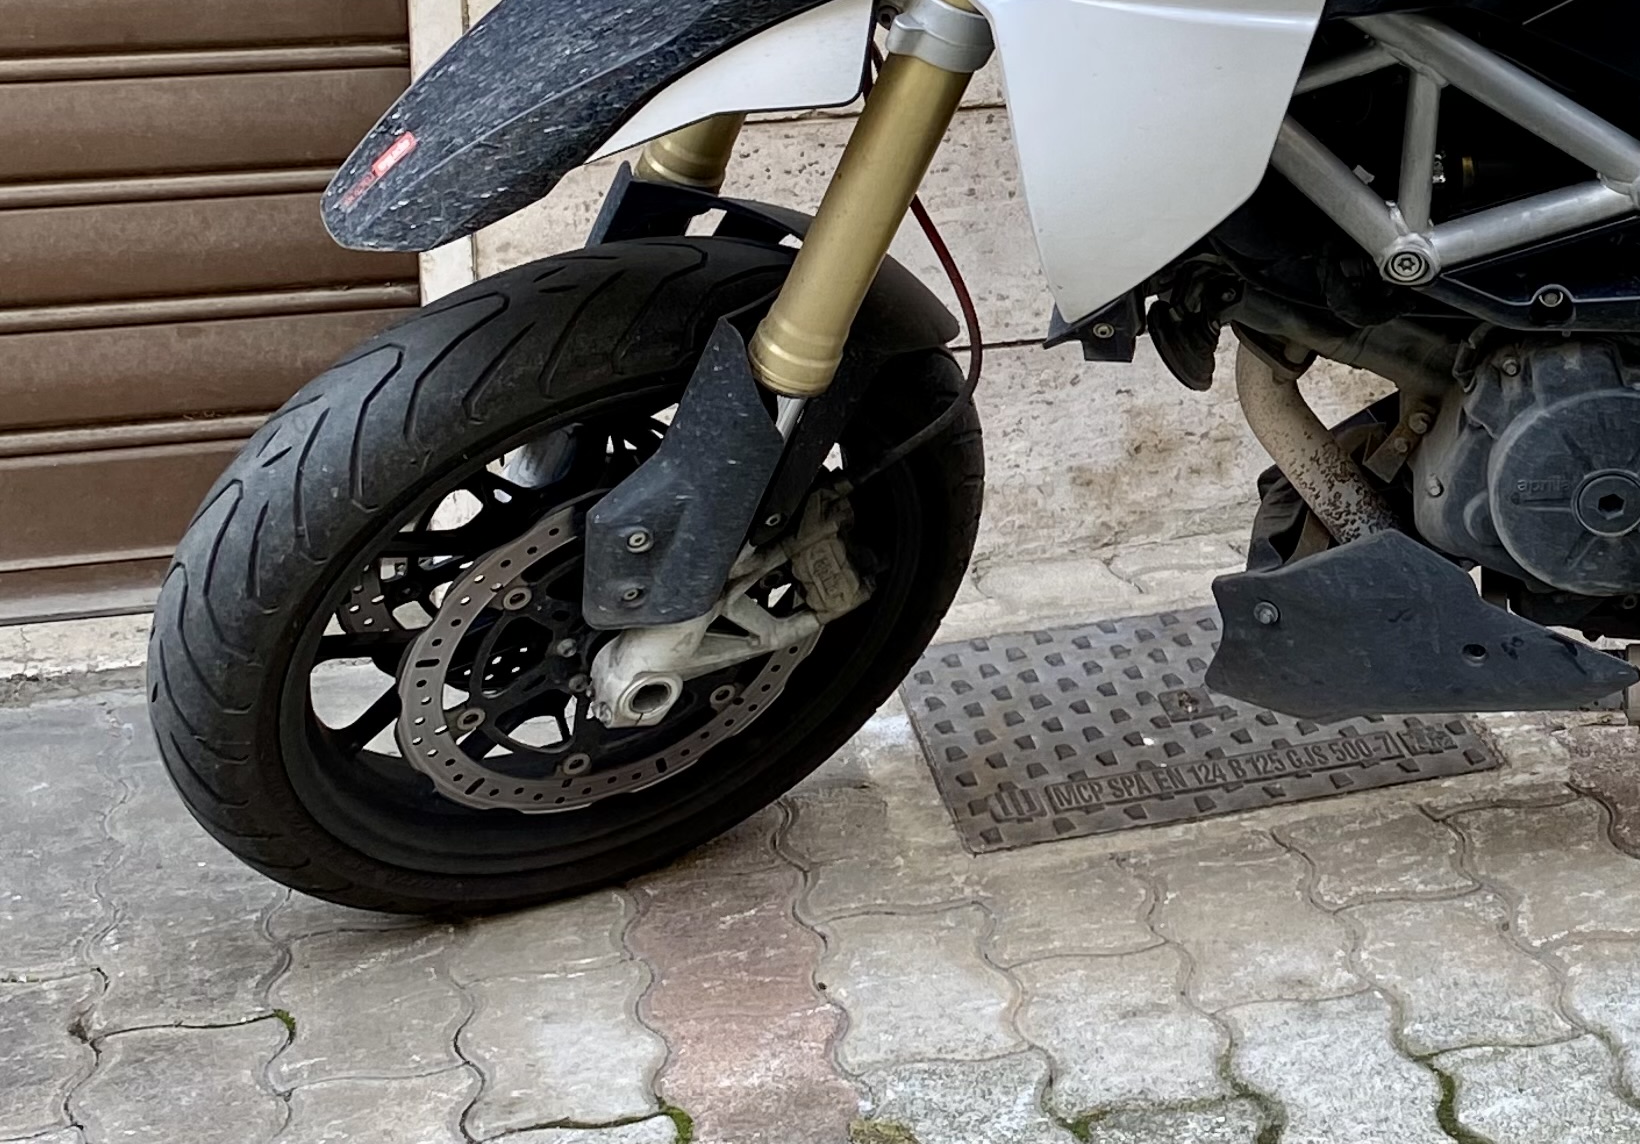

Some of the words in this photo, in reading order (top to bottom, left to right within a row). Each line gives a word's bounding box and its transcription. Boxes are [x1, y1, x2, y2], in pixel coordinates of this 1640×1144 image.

[1053, 784, 1104, 808] MCP
[1107, 772, 1151, 799] SPA
[1152, 767, 1187, 792] EN
[1187, 761, 1227, 786] 124
[1228, 757, 1247, 780] B
[1249, 751, 1287, 776] 125
[1329, 734, 1395, 763] 500-7
